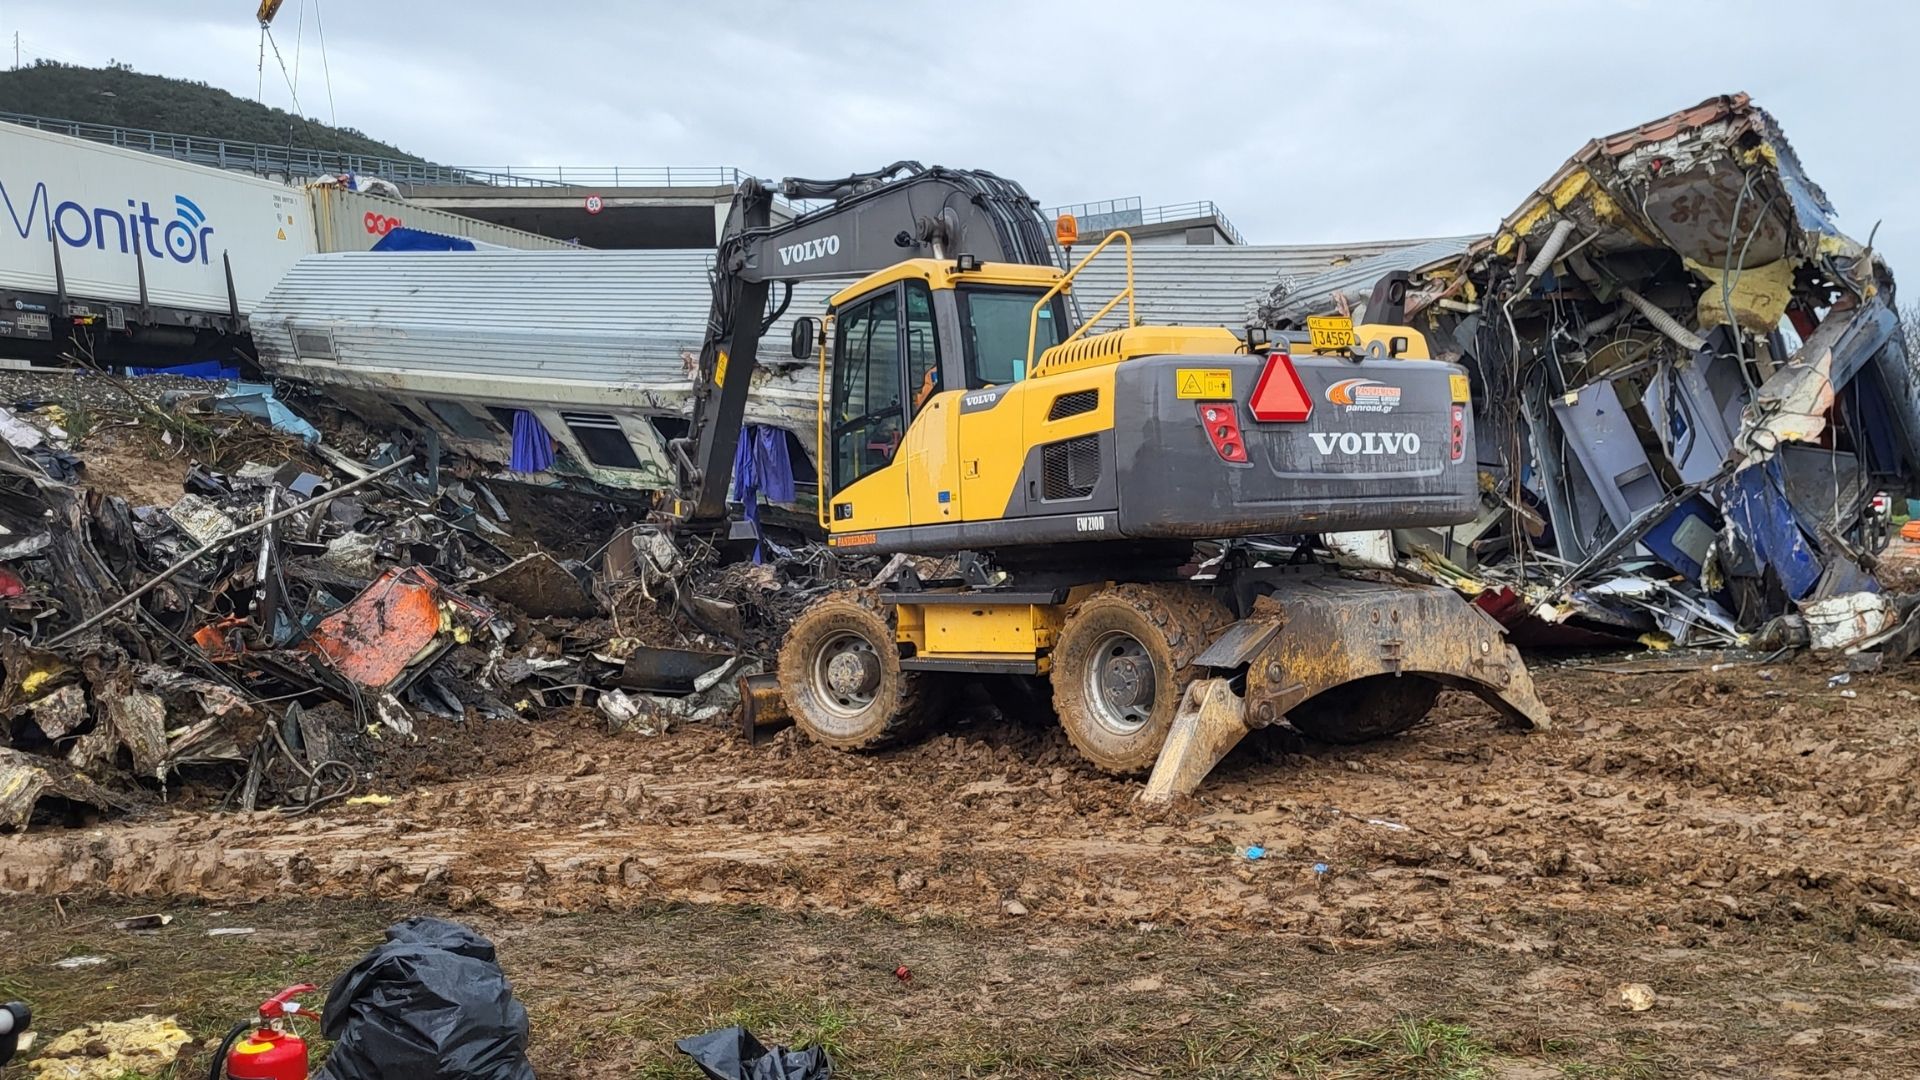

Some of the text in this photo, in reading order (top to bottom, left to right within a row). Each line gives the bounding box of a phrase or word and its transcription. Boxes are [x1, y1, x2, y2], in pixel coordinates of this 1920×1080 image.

[0, 179, 214, 265] Monitor
[778, 234, 840, 266] VOLVO
[1311, 319, 1322, 328] ME
[1313, 330, 1352, 346] 134562
[965, 392, 997, 407] VOLVO
[1345, 404, 1393, 414] panroad.gr
[1308, 432, 1421, 455] VOLVO
